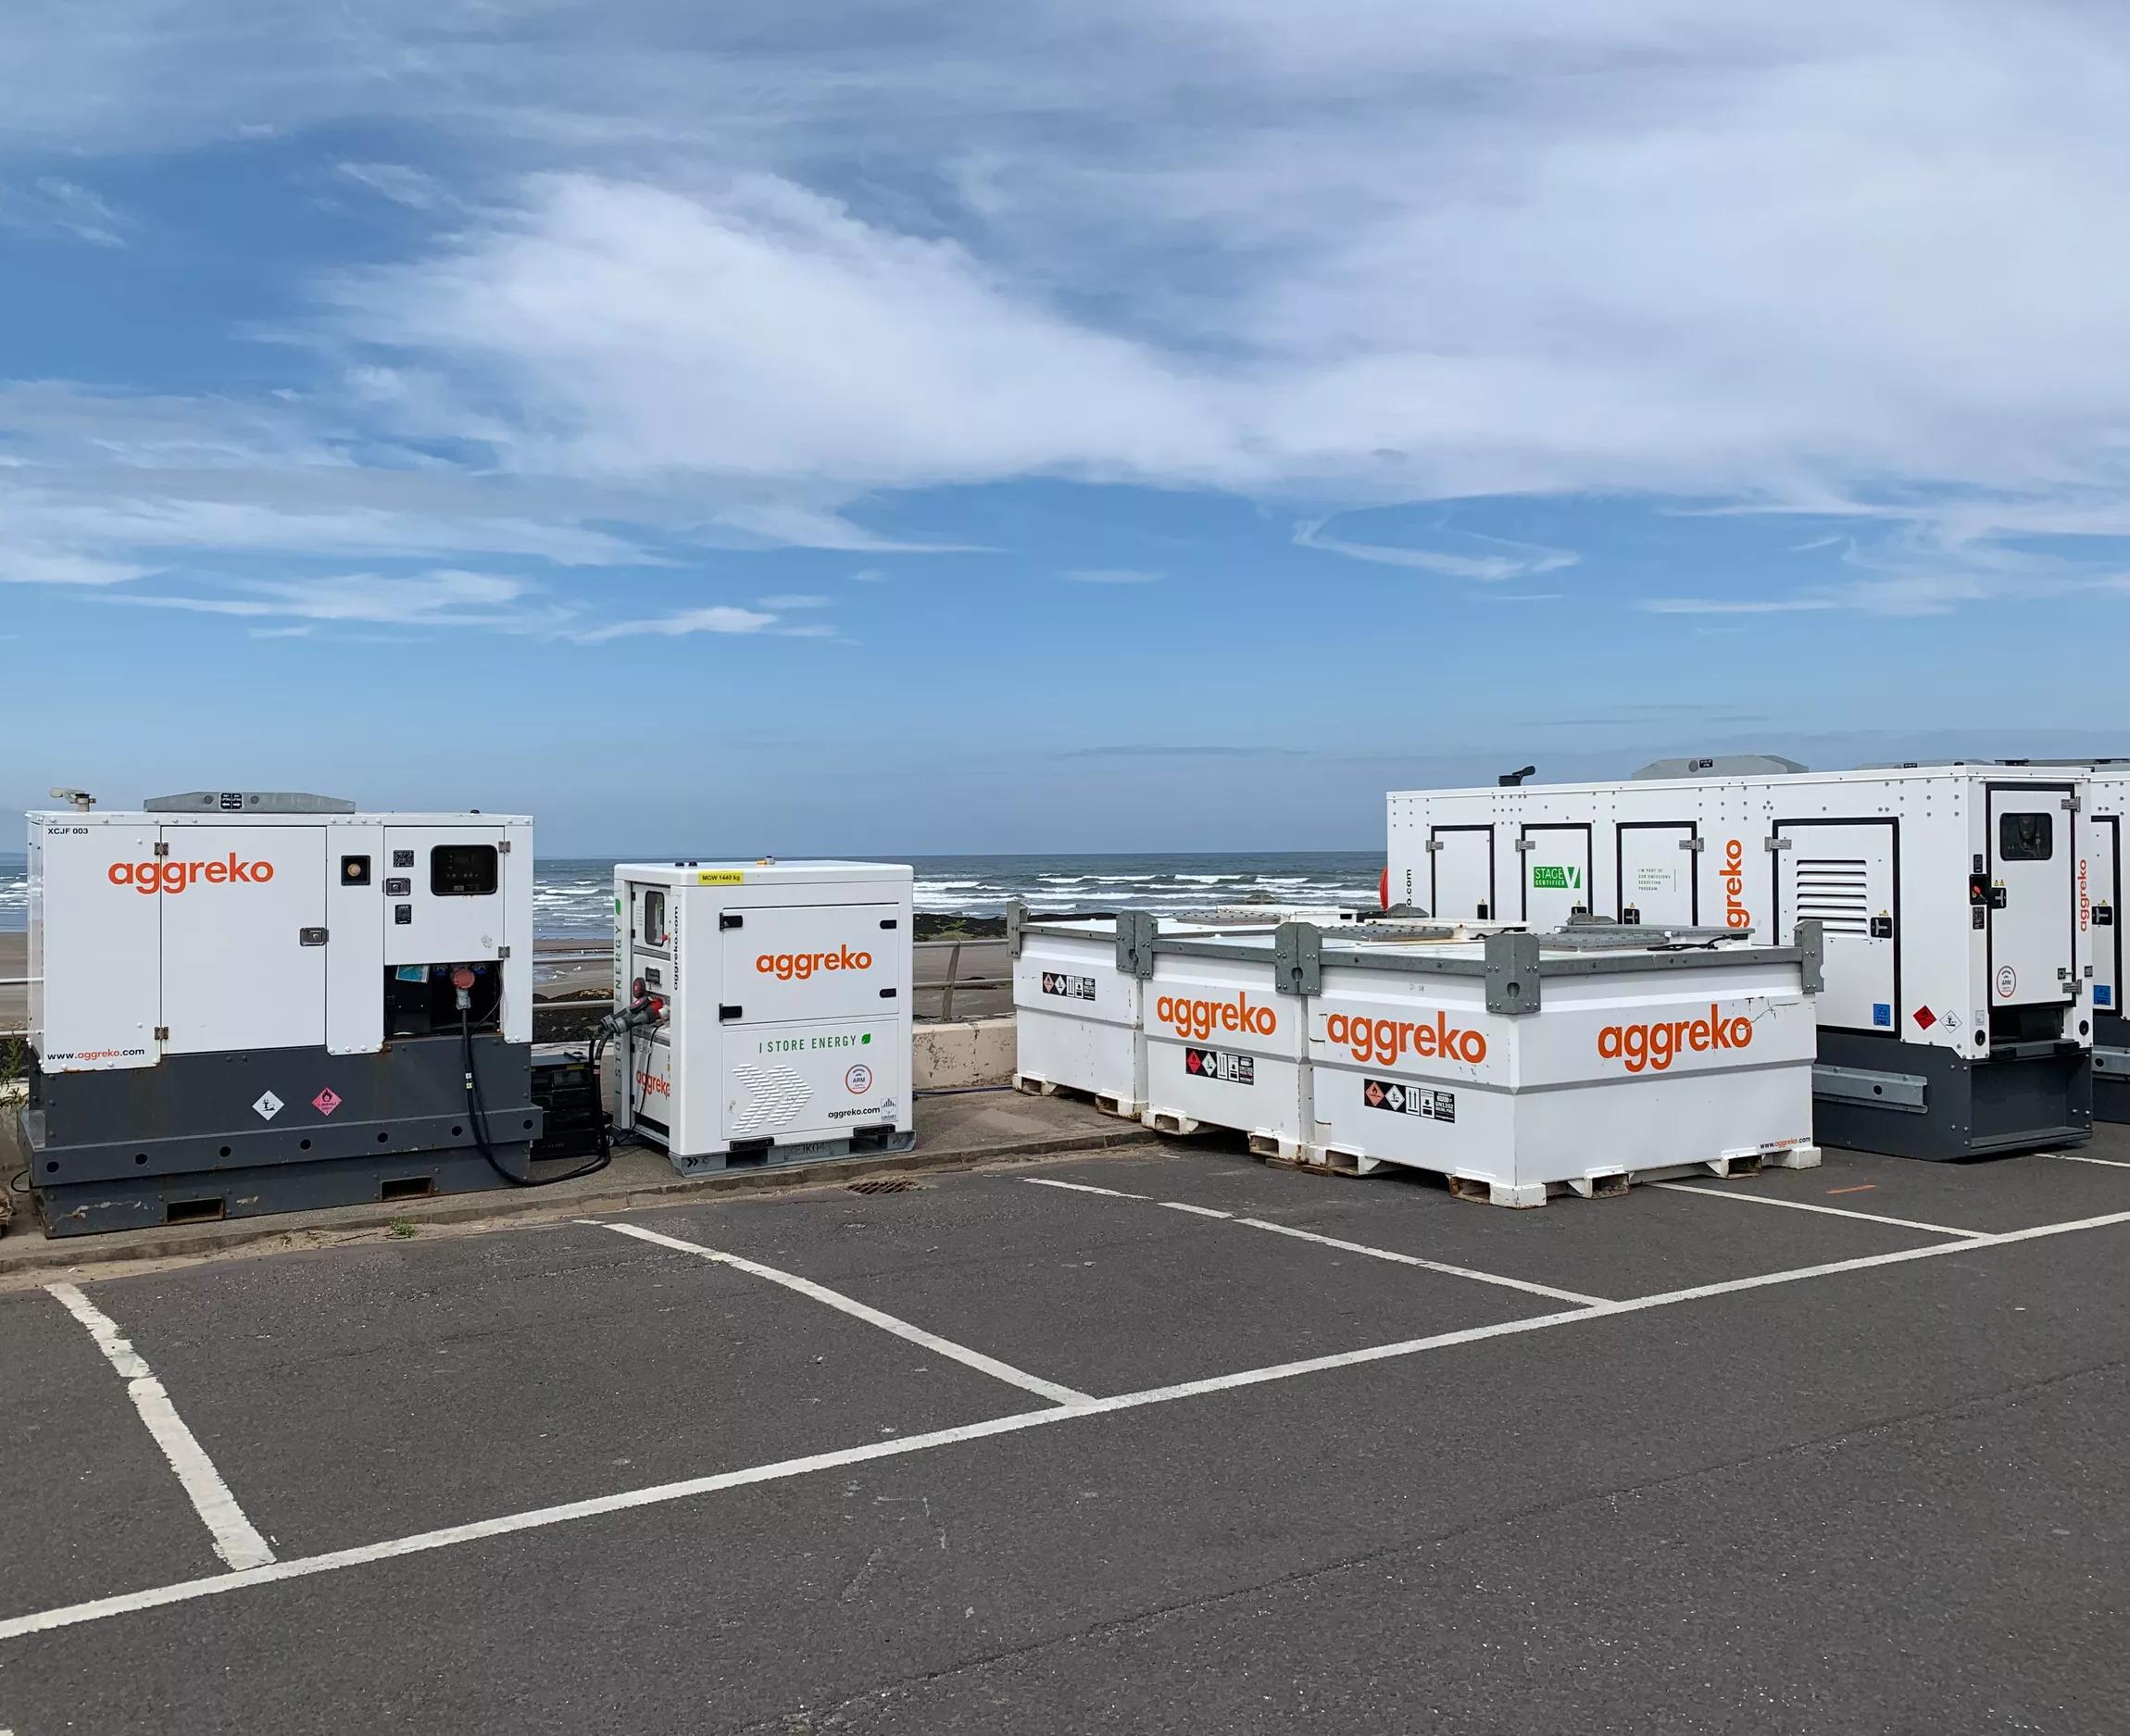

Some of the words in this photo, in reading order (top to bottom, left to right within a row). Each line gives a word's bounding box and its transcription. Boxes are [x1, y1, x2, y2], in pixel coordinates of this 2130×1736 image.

[47, 827, 70, 835] XCJF
[72, 827, 89, 835] 003
[107, 852, 274, 894] aggreko
[1535, 868, 1564, 880] STAGE
[1719, 840, 1750, 928] greko
[2077, 859, 2090, 932] aggreko
[756, 943, 873, 981] aggreko
[1157, 991, 1277, 1042] aggreko
[46, 1047, 145, 1061] www.aggreko.com
[767, 1039, 806, 1054] STORE
[811, 1035, 857, 1049] ENERGY
[1326, 1010, 1487, 1067] aggreko
[1598, 1003, 1754, 1073] aggreko
[828, 1106, 881, 1119] aggreko.com
